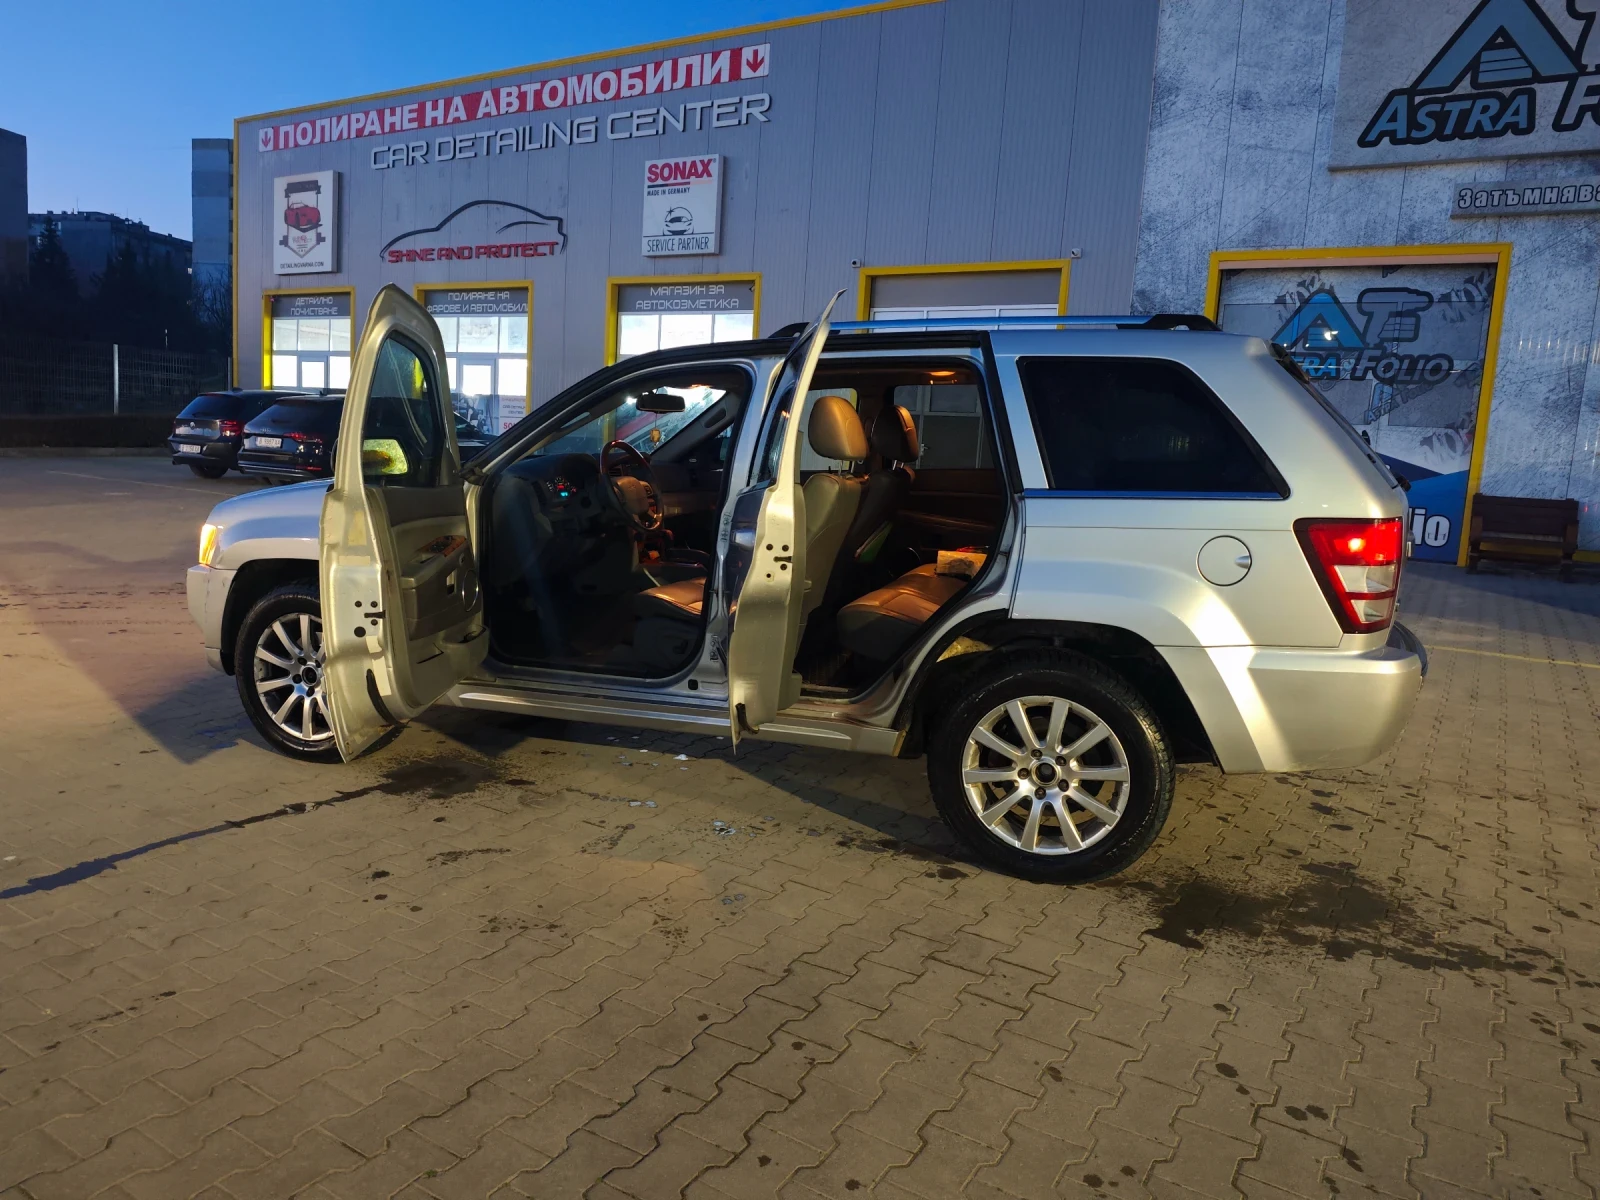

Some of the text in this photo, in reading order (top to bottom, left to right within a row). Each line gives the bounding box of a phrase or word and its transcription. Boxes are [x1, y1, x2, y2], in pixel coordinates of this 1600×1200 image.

[278, 50, 730, 149] ПОЛИРАНЕ НА АВТОМОБИЛИ
[1360, 90, 1533, 146] ASTRA
[371, 93, 771, 170] CAR DETAILING CENTER
[647, 158, 713, 183] SONAX
[668, 187, 690, 195] GERMANY
[647, 236, 709, 252] SERVICE PARTNER
[388, 241, 559, 263] SHINE AND PROTECT
[448, 291, 509, 300] ПОЛИРАНЕ НА
[650, 285, 725, 296] МАГАЗИН ЗА
[291, 306, 338, 315] ПОЧИСТВАНЕ
[463, 304, 469, 312] И
[470, 303, 528, 312] АВТОМОБИЛ
[636, 298, 739, 310] АВТОКОЗМЕТИКА
